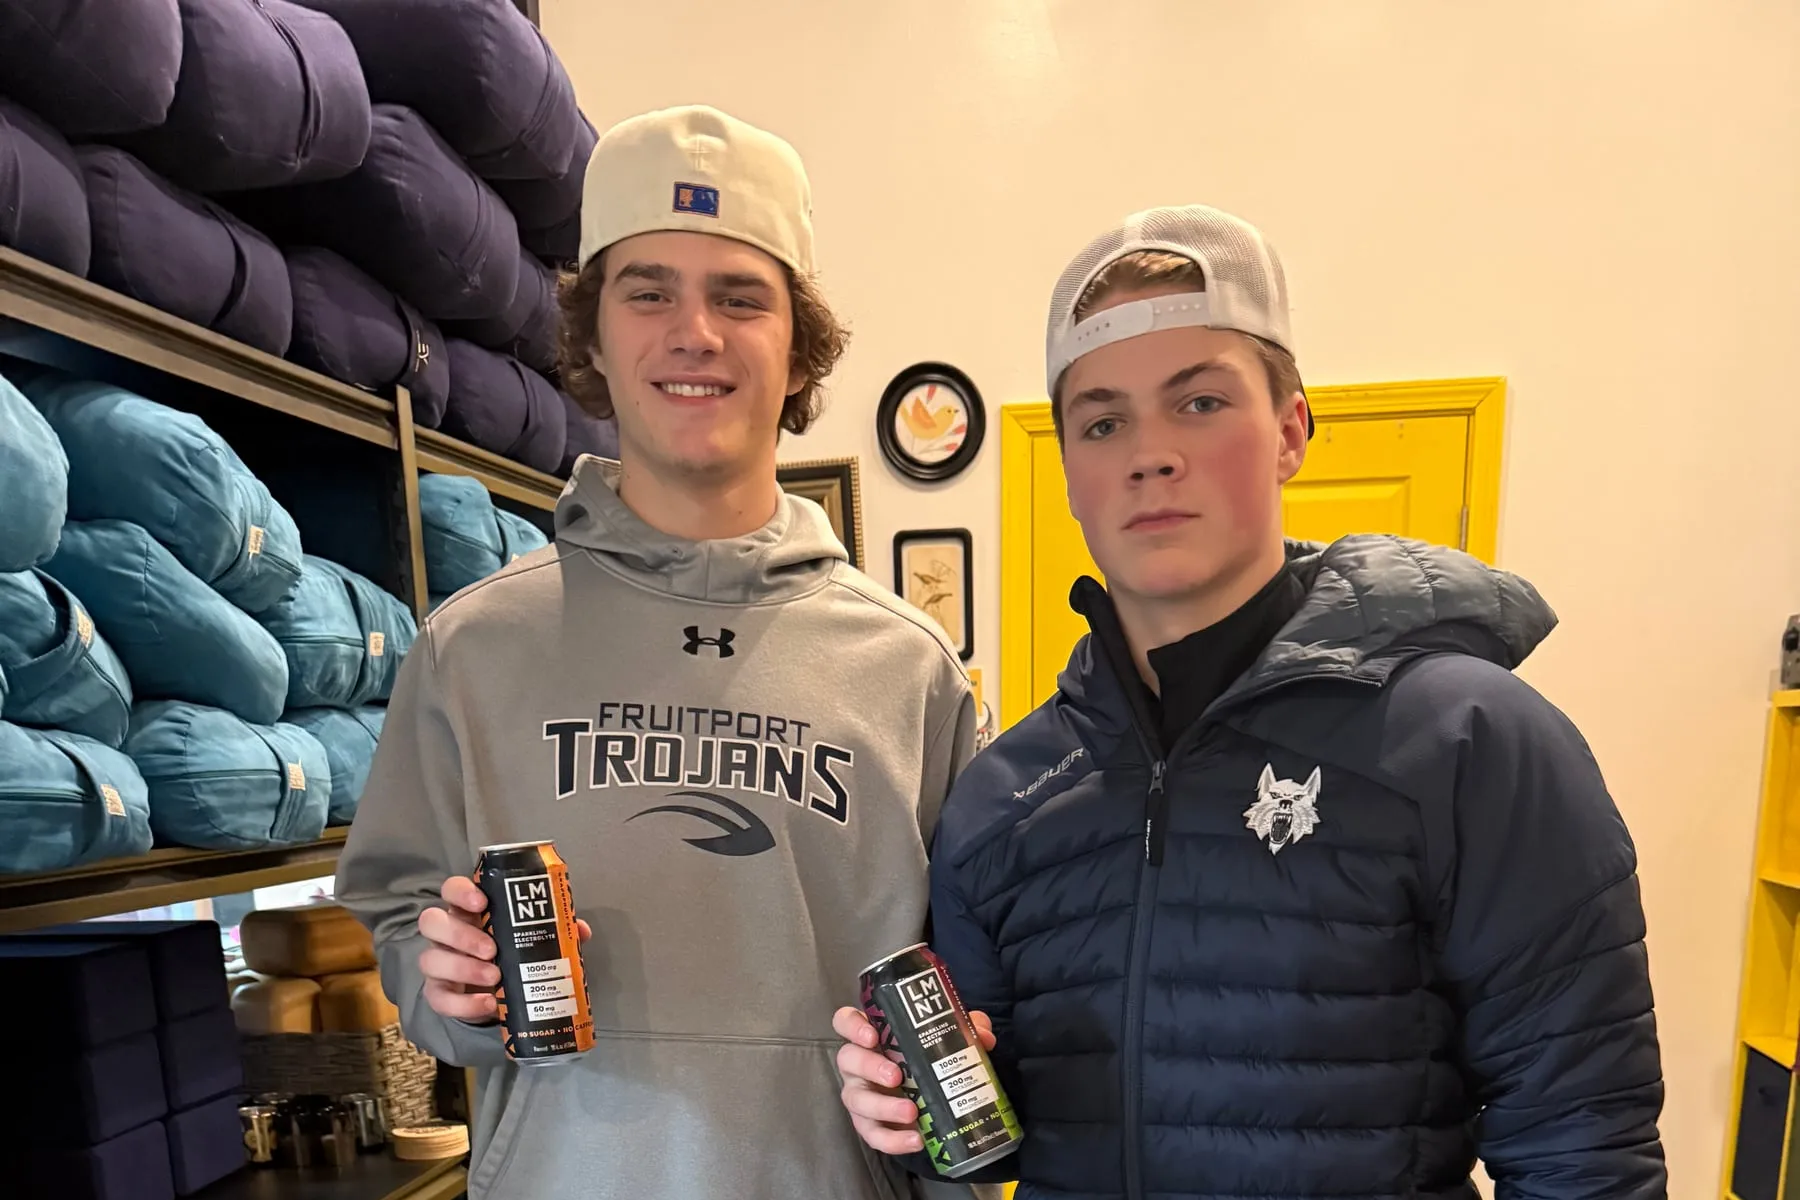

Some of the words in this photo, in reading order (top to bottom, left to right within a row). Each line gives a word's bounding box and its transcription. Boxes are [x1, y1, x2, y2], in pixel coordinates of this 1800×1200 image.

[599, 702, 811, 746] FRUITPORT
[542, 718, 854, 826] TROJANS
[1026, 747, 1085, 796] BAUER
[514, 882, 547, 901] LM
[517, 900, 548, 919] NT
[514, 933, 556, 944] ELECTROLYTE
[526, 964, 547, 973] 1000
[547, 964, 557, 972] mg
[530, 985, 546, 993] 200
[547, 985, 557, 993] mg
[907, 976, 938, 1001] LM
[533, 1005, 544, 1013] 60
[915, 993, 942, 1018] NT
[529, 1029, 555, 1038] SUGAR
[920, 1024, 957, 1044] ELECTROLYTE
[922, 1037, 943, 1049] WATER
[939, 1058, 958, 1070] 1000
[948, 1078, 963, 1088] 200
[957, 1098, 967, 1107] 60
[946, 1131, 958, 1140] NO
[959, 1118, 985, 1135] SUGAR
